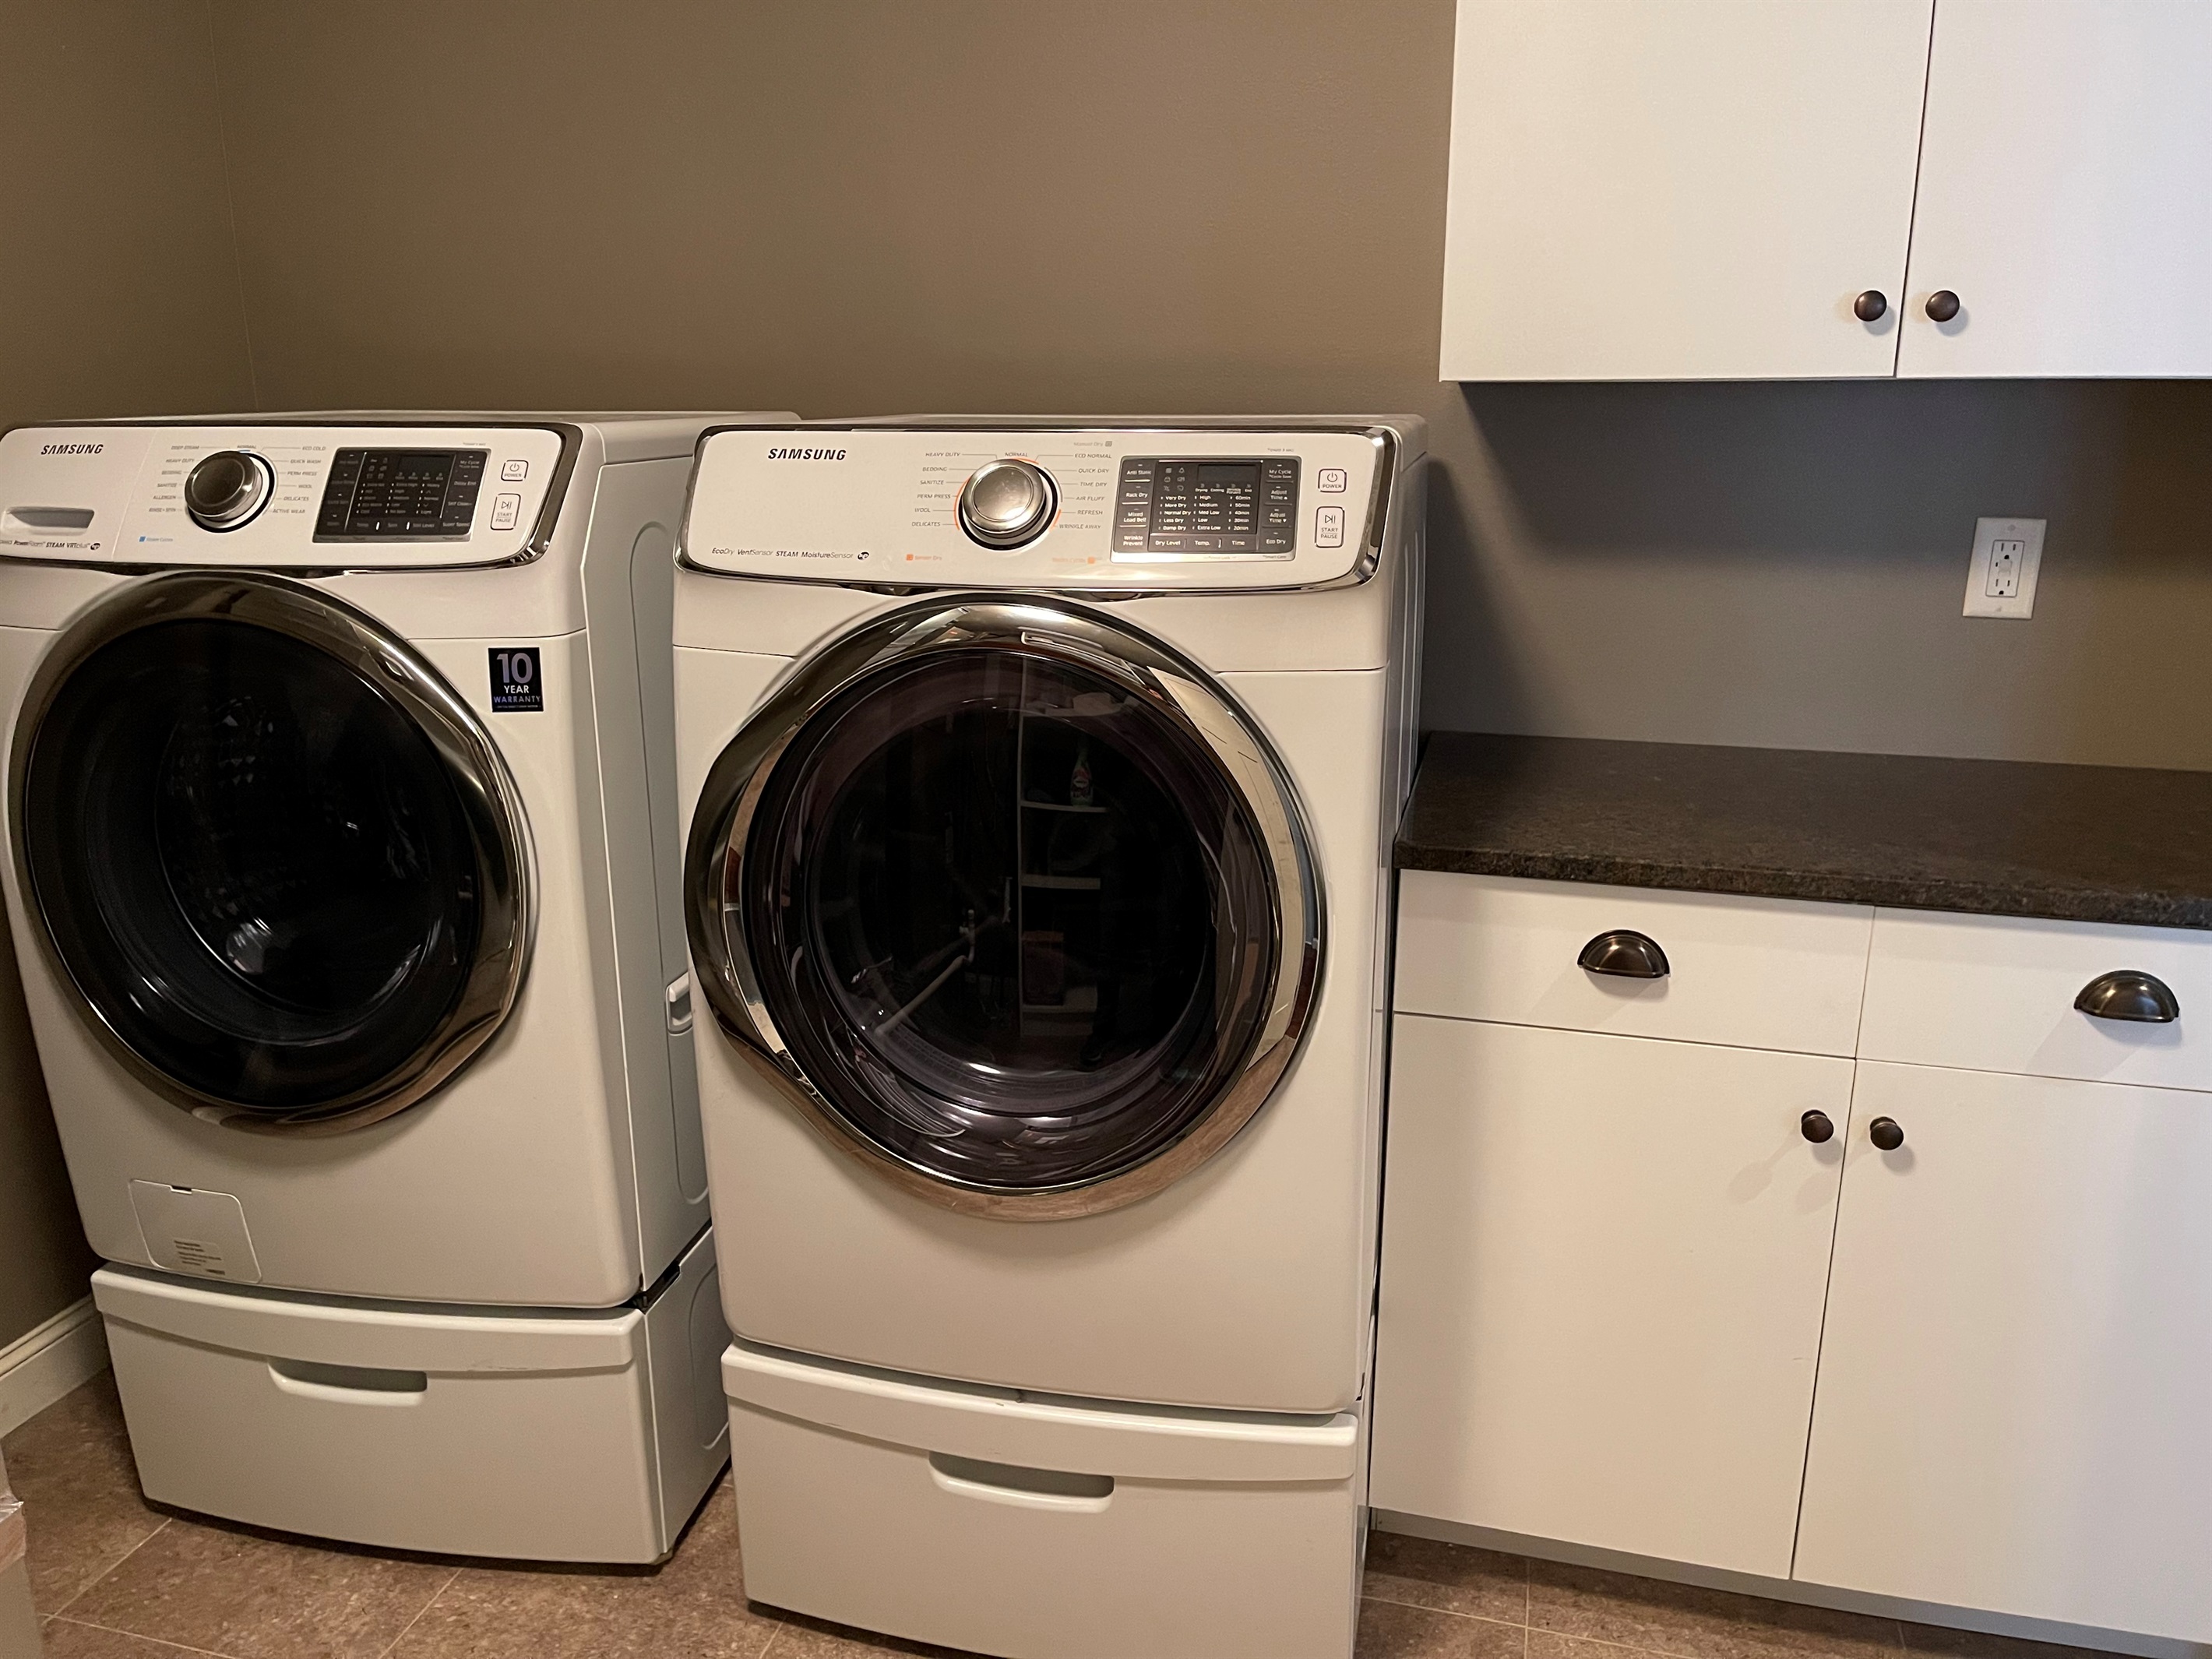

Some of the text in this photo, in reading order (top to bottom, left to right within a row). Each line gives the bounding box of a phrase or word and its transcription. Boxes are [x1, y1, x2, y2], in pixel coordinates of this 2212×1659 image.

[41, 444, 104, 455] SAMSUNG
[767, 448, 847, 460] SAMSUNG
[496, 653, 532, 684] 10
[503, 685, 530, 694] YEAR
[493, 695, 541, 703] WARRANTY
